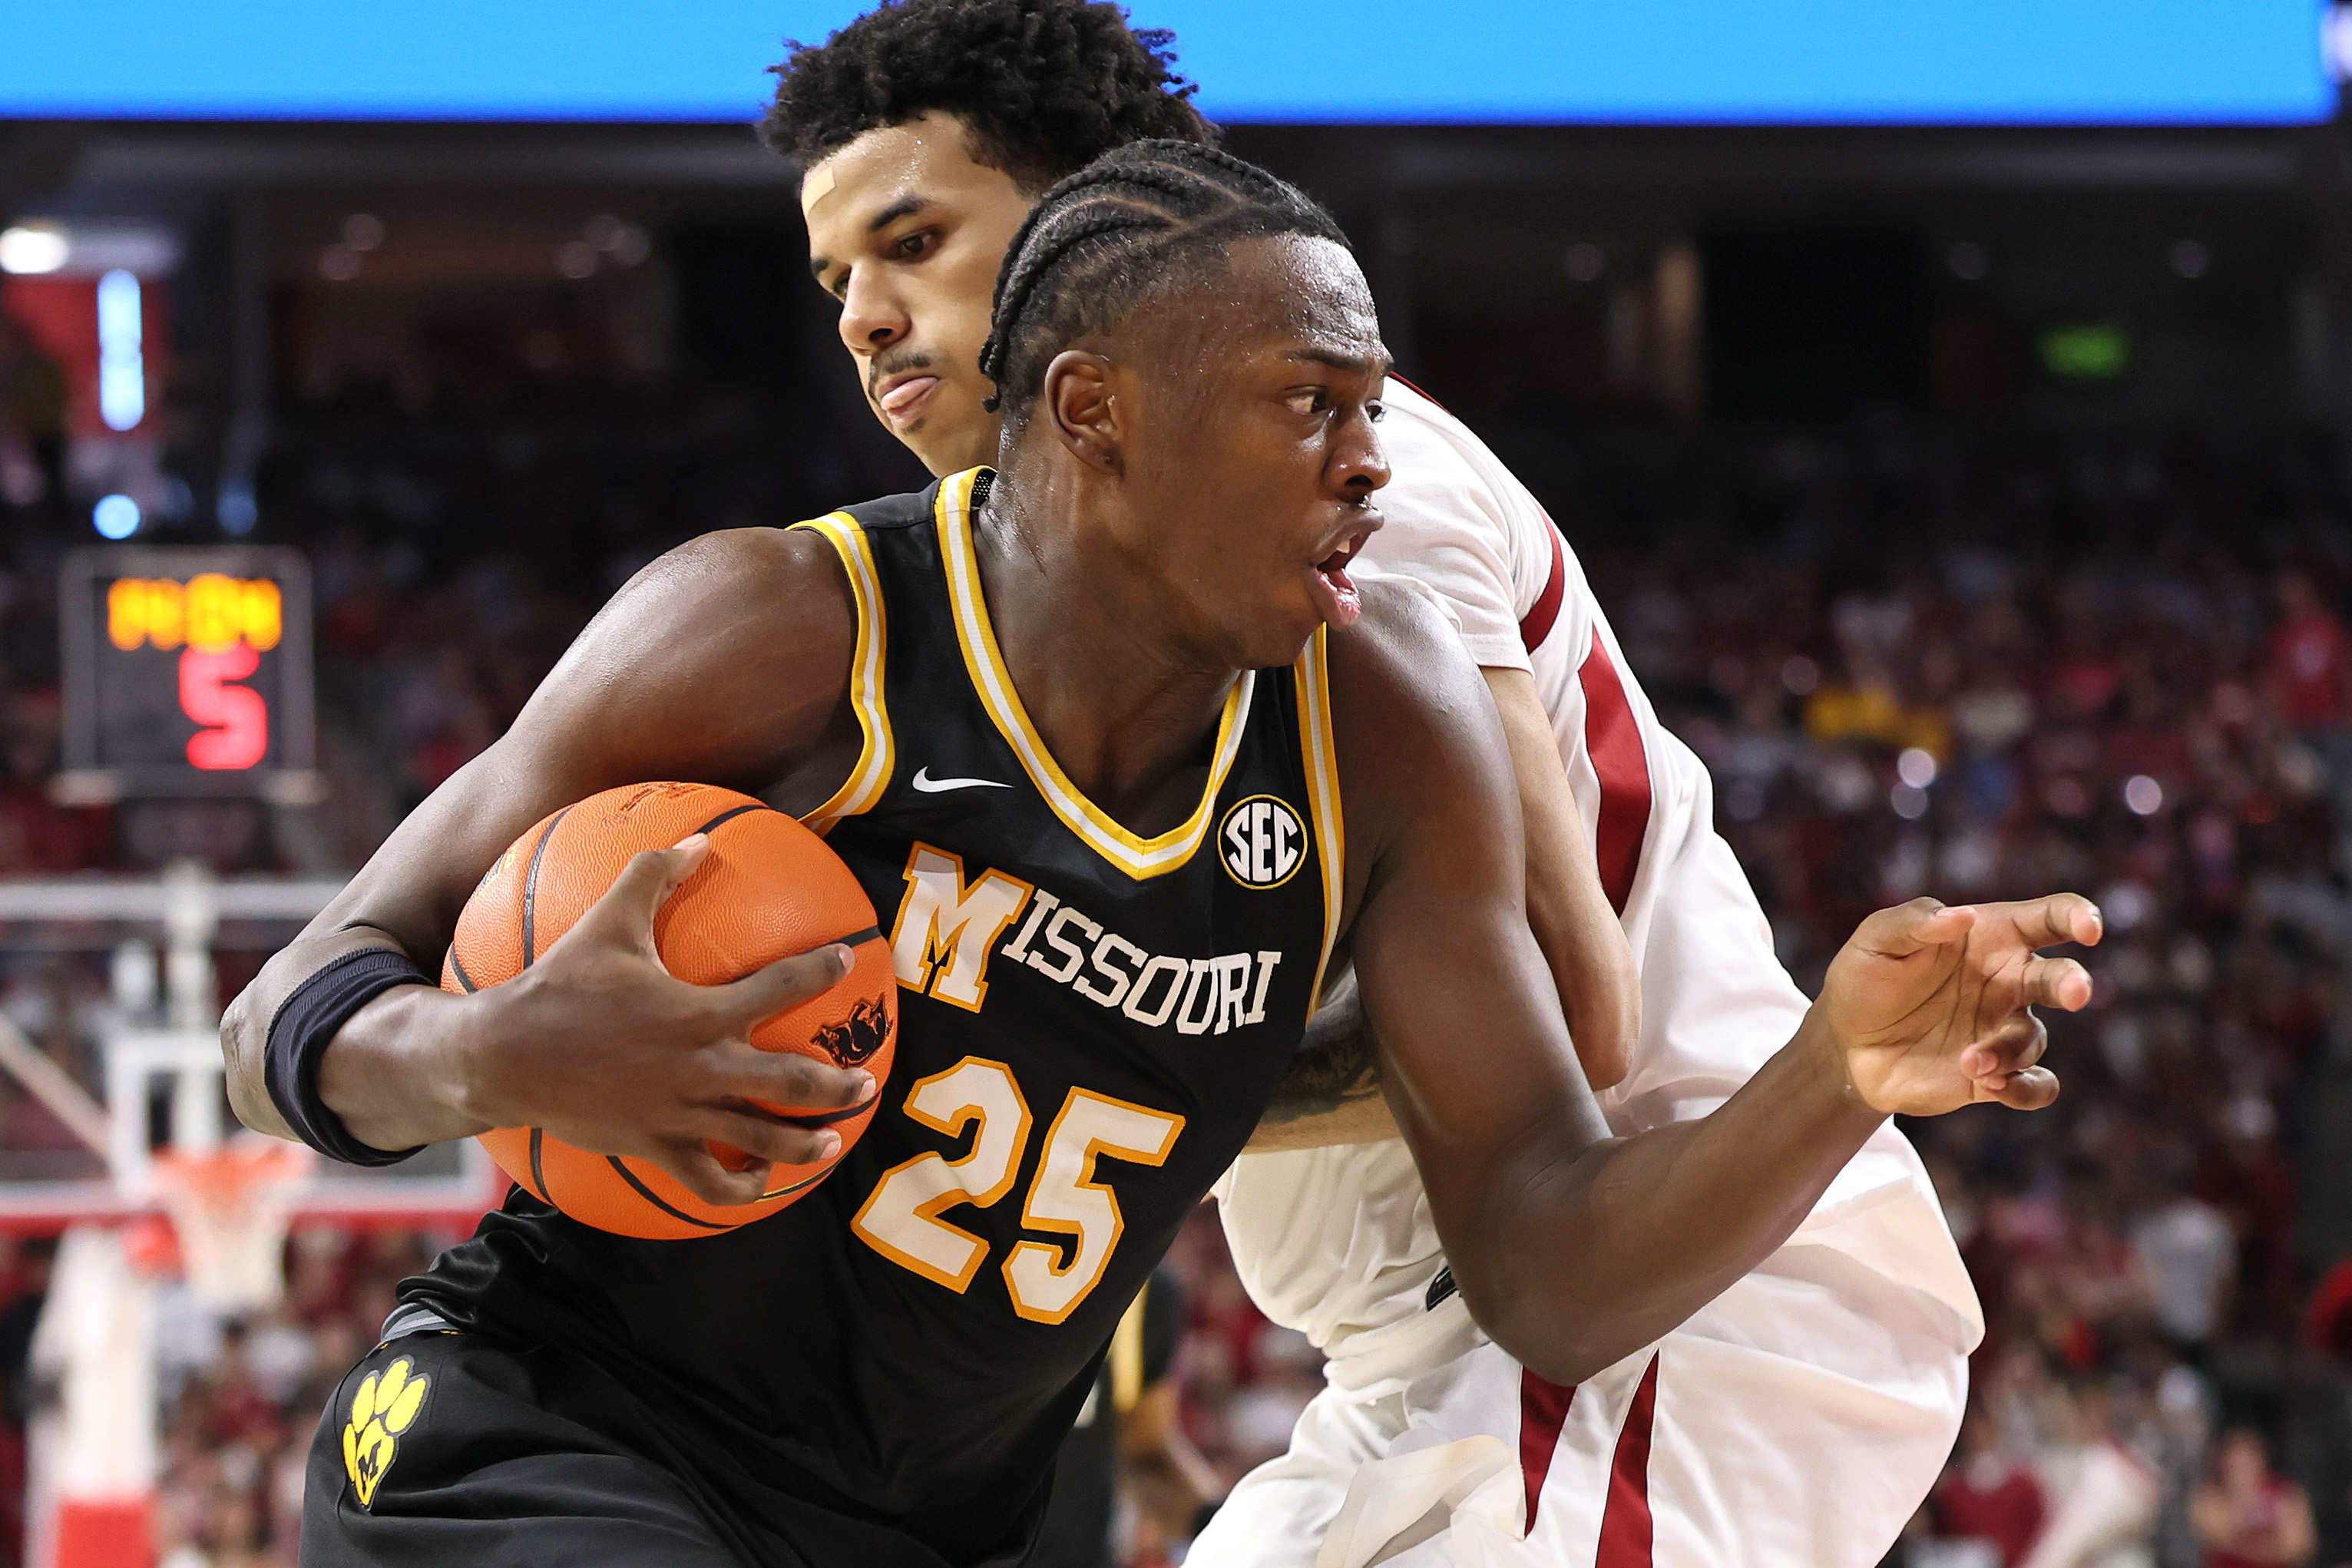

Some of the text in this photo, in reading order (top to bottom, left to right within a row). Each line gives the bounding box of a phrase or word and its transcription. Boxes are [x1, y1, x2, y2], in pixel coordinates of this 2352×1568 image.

[889, 841, 1282, 1035] MISSOURI
[1226, 802, 1298, 882] SEC
[850, 1056, 1186, 1325] 25
